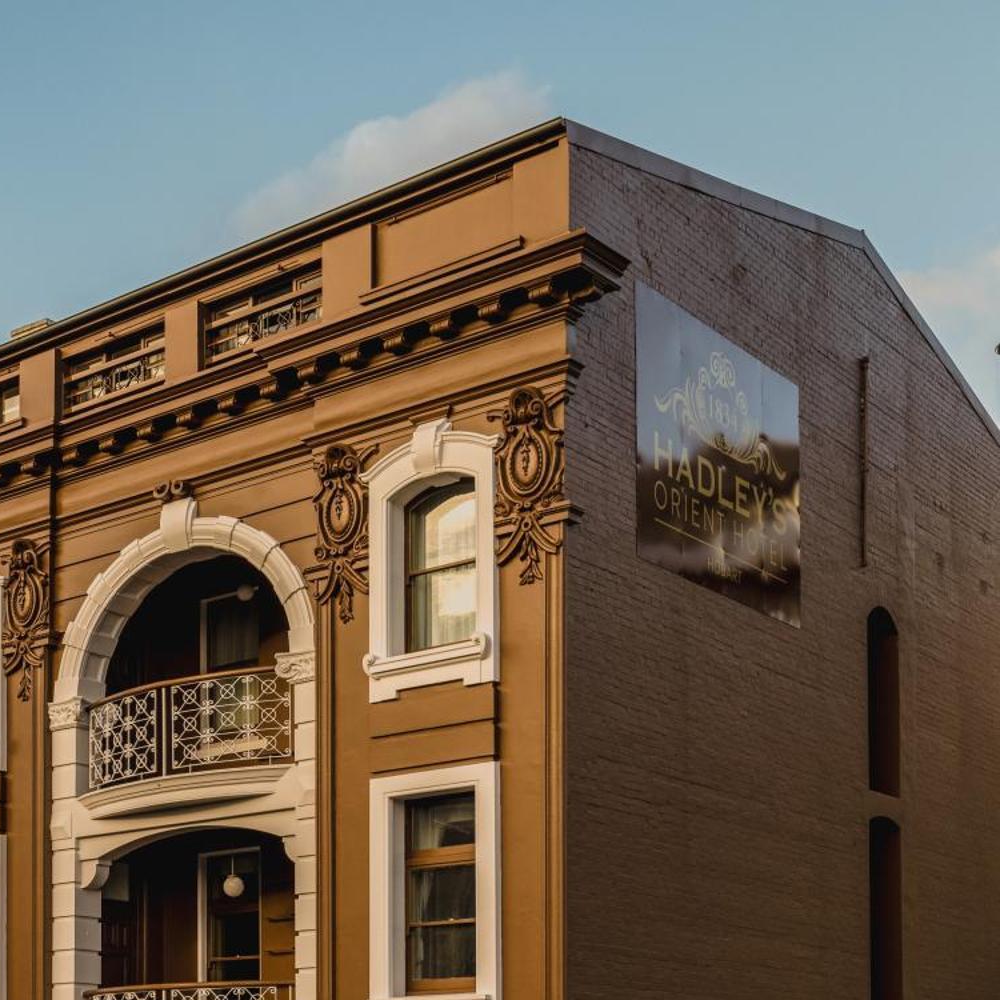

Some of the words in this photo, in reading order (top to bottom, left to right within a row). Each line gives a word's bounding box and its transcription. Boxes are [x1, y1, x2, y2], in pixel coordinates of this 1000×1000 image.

[654, 431, 787, 536] HADLEY'S
[654, 480, 725, 536] ORIENT
[733, 521, 788, 572] HOTEL
